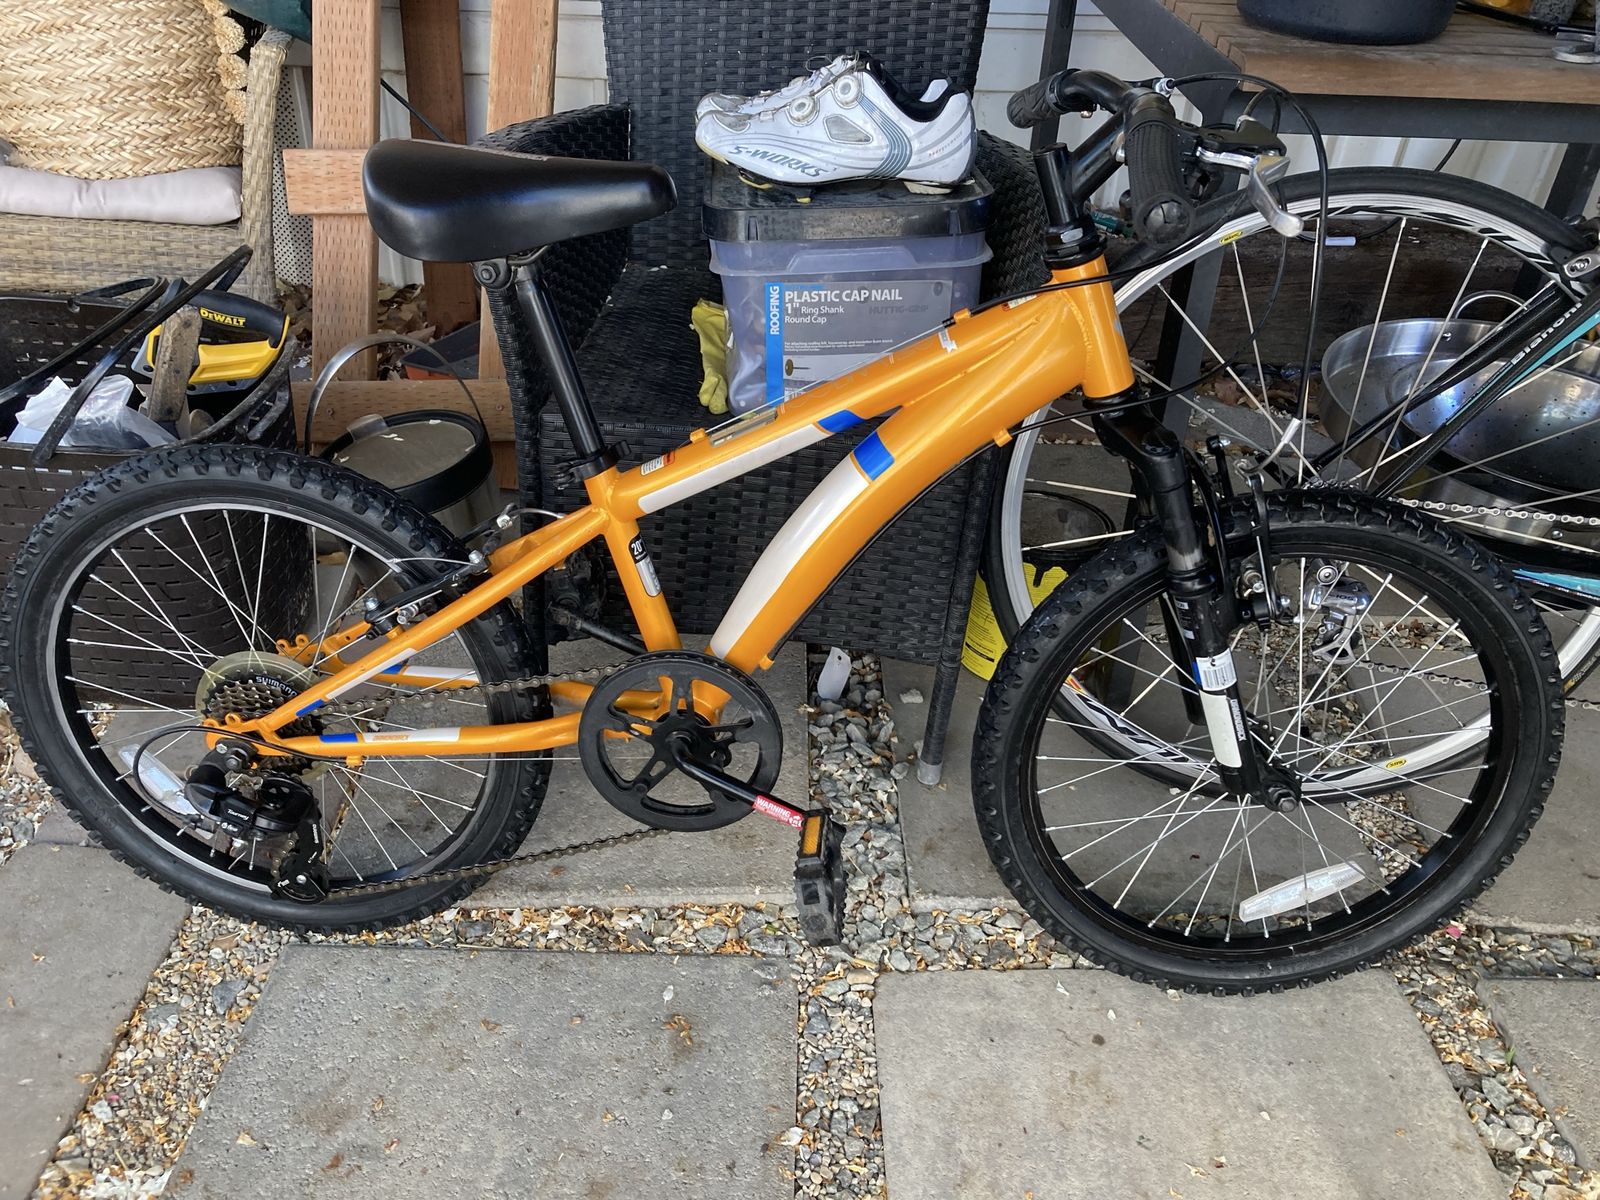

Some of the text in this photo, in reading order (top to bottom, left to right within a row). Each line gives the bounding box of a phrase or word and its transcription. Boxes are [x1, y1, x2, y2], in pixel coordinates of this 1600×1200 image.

[728, 146, 829, 177] S-WORKS
[784, 289, 903, 303] PLASTIC CAP NAIL
[769, 285, 780, 336] ROOFING
[785, 302, 845, 316] 1" Ring Shank
[784, 315, 828, 325] Round Cap
[227, 808, 250, 821] Tourney
[756, 797, 792, 818] WARNING
